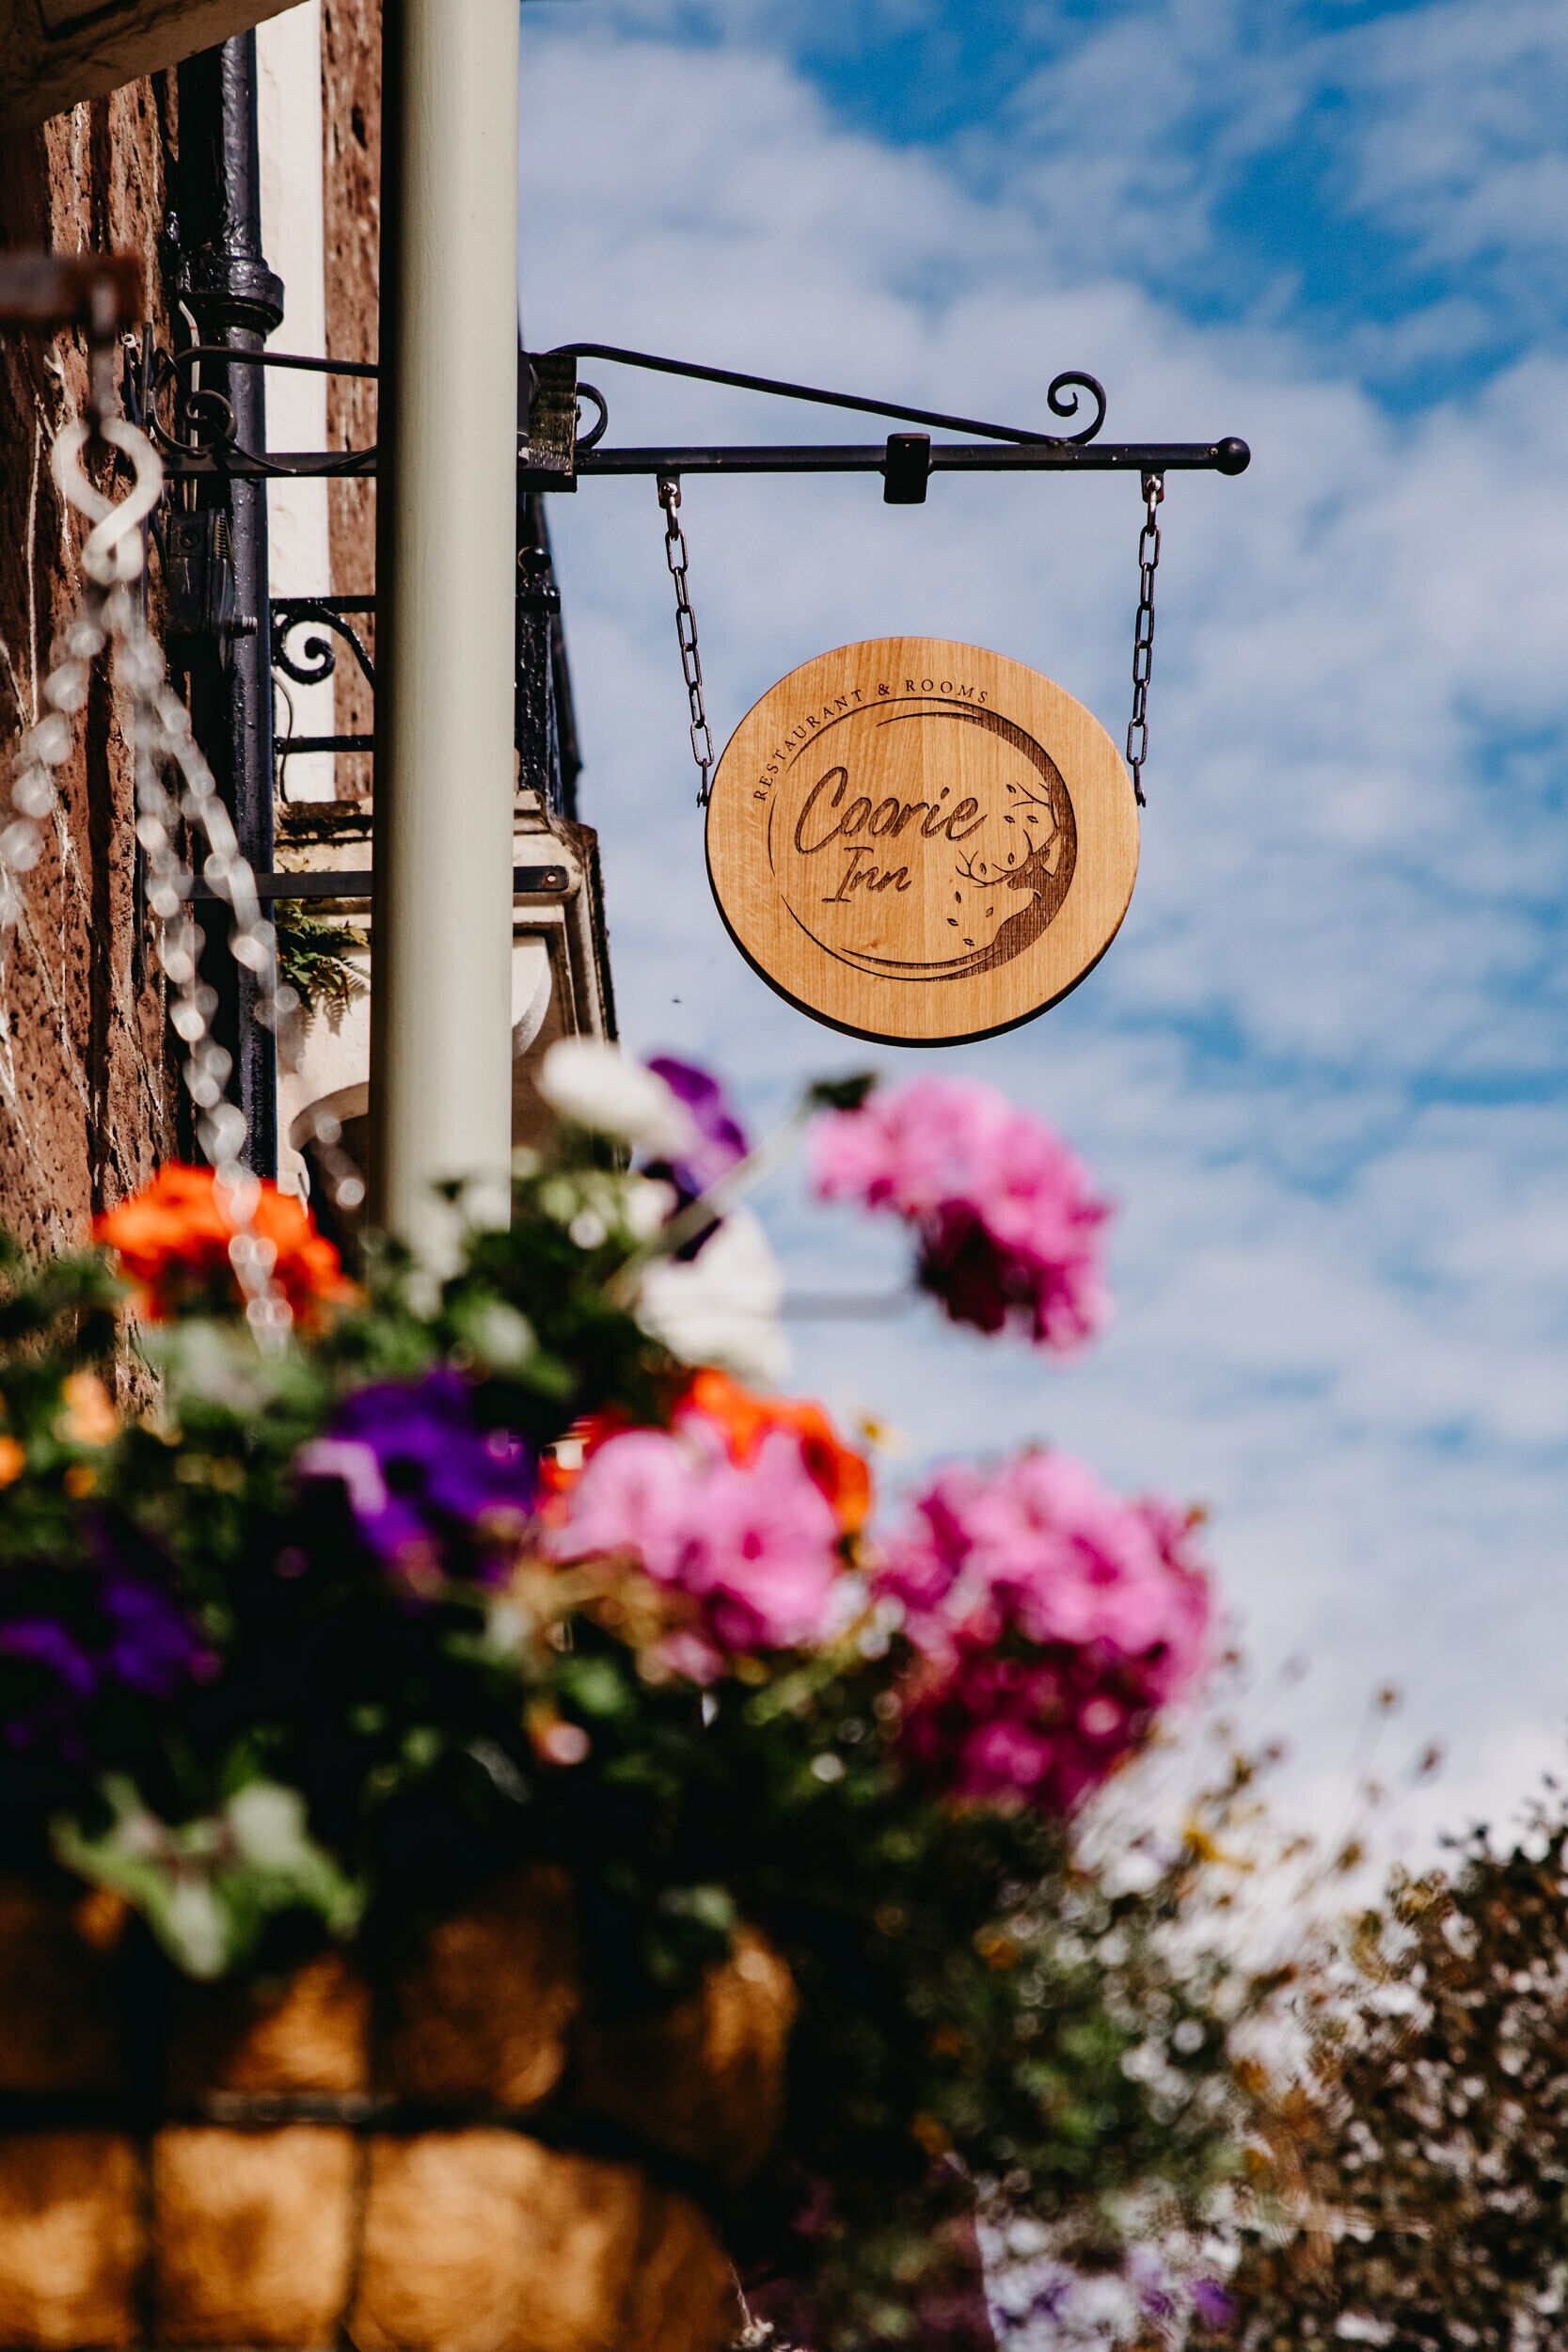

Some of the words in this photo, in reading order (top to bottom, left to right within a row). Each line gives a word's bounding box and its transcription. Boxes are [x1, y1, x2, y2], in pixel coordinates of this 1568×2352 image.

[753, 689, 864, 803] RESTAURANT
[878, 682, 891, 696] &
[905, 678, 990, 704] ROOMS
[794, 766, 989, 855] Coorie
[821, 847, 911, 903] Inn
